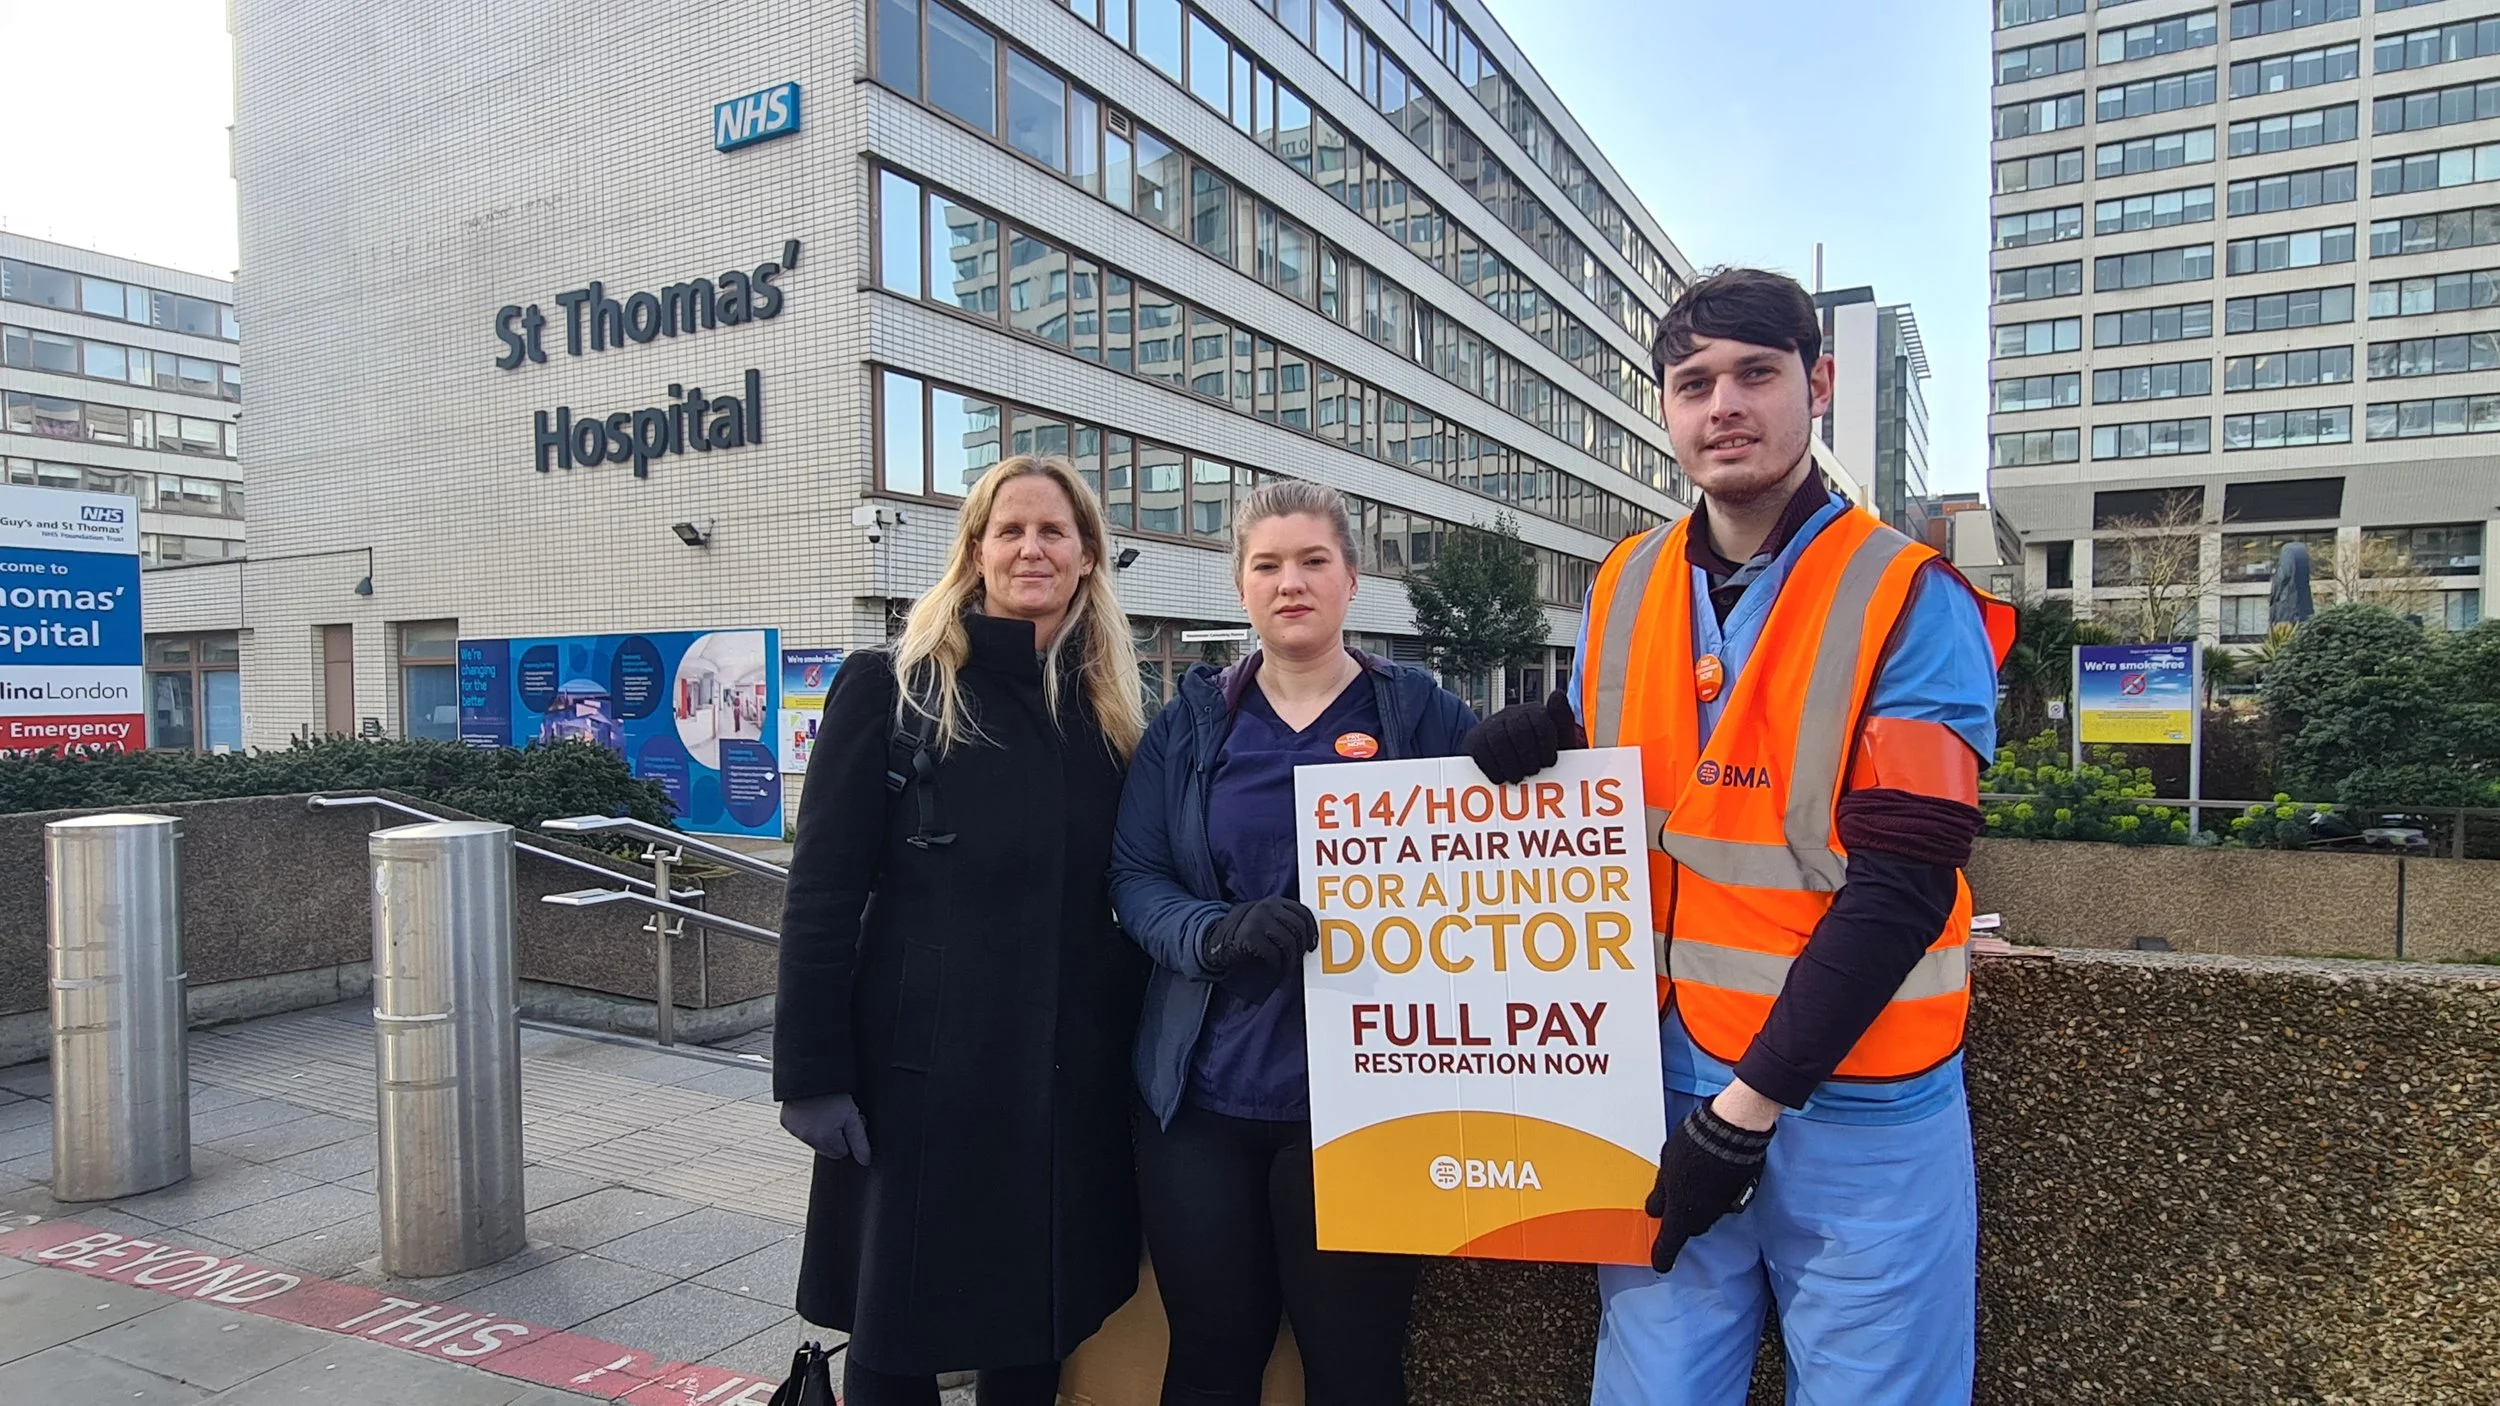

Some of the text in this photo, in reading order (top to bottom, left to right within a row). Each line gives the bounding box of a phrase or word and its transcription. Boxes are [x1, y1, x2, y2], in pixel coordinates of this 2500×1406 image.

[717, 86, 789, 146] NHS
[495, 238, 800, 370] St Thomas'
[534, 368, 762, 479] Hospital
[0, 516, 124, 534] Guy's and St Thomas'
[82, 507, 122, 521] NHS
[61, 532, 105, 541] Foundation
[0, 562, 69, 575] come to
[461, 648, 482, 661] We're
[2084, 660, 2185, 671] We're smoke-free
[461, 664, 496, 679] changing
[461, 680, 488, 691] for the
[461, 696, 486, 707] better
[10, 721, 131, 740] Emergency
[1722, 765, 1771, 788] BMA
[1314, 778, 1624, 829] £14/HOUR IS
[1316, 826, 1627, 866] NOT A FAIR WAGE
[1317, 866, 1631, 913] FOR A JUNIOR
[1319, 911, 1635, 975] DOCTOR
[1352, 1002, 1608, 1046] FULL PAY
[1354, 1053, 1610, 1075] RESTORATION NOW
[1465, 1159, 1543, 1190] BMA
[38, 1232, 302, 1304] BEYOND
